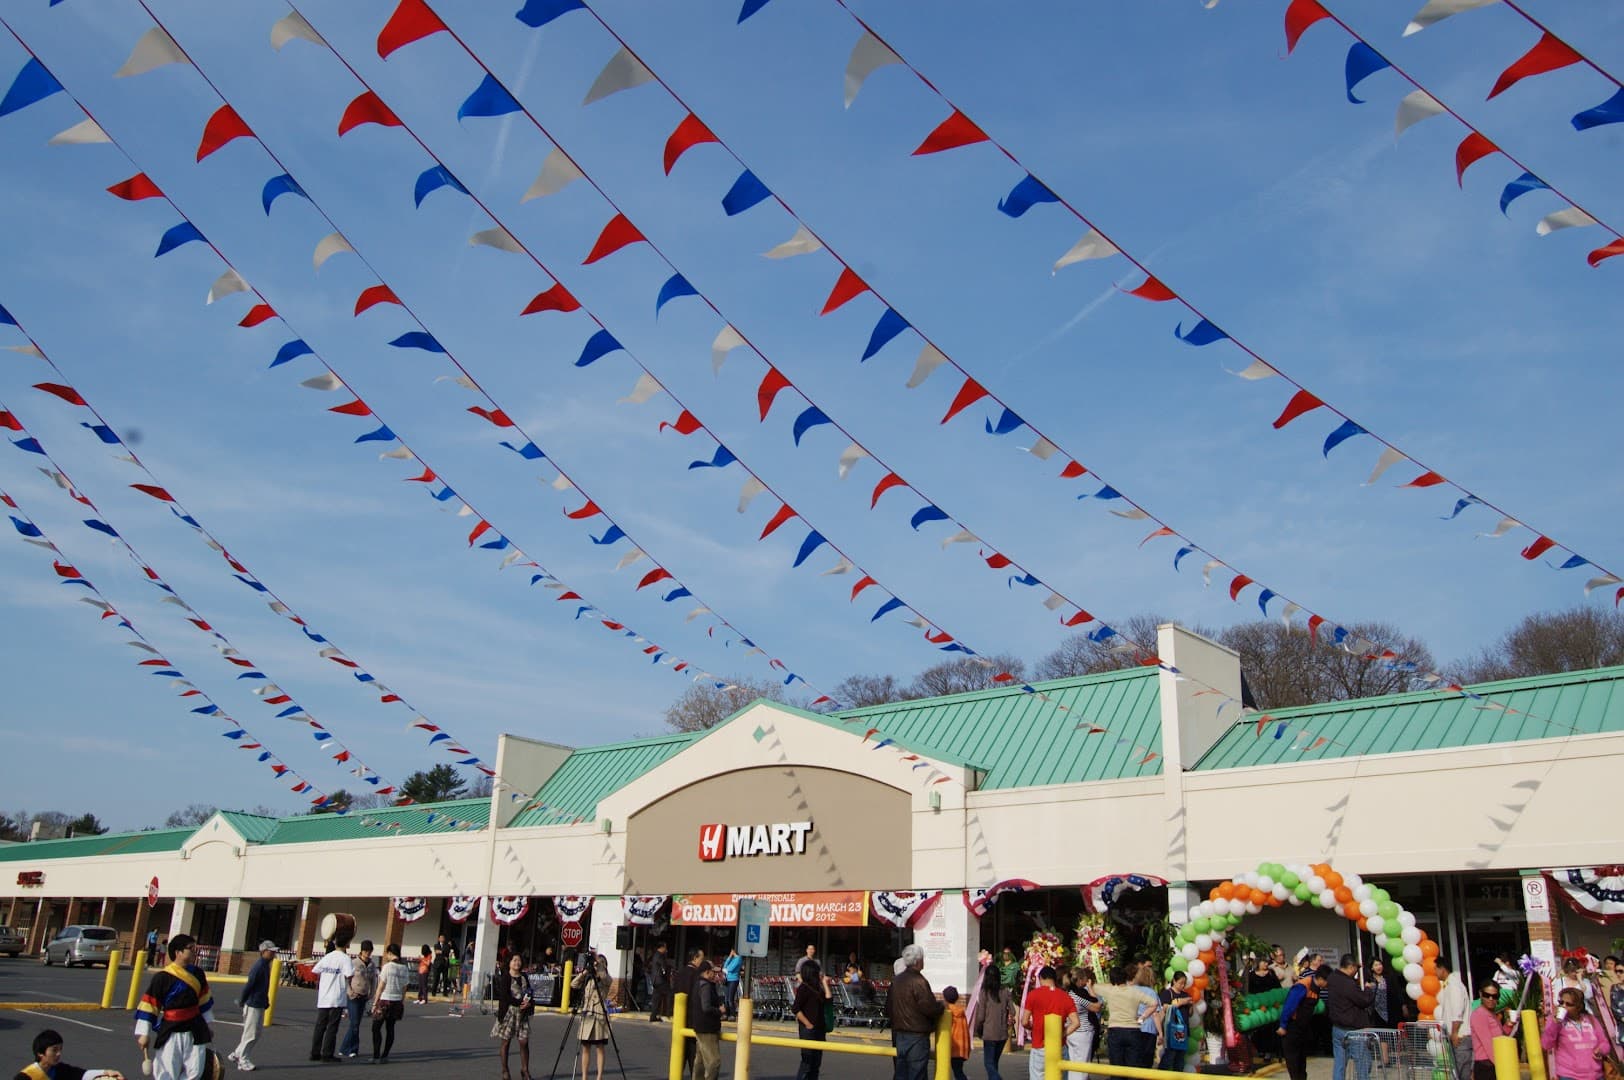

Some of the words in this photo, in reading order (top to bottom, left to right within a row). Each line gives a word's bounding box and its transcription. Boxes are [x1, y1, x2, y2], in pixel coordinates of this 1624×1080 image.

[701, 824, 722, 859] H
[726, 822, 812, 855] MART
[682, 904, 737, 922] GRAND
[769, 903, 815, 922] NING
[816, 903, 847, 913] MARCH
[848, 902, 862, 912] 23
[815, 913, 836, 921] 2012
[563, 928, 581, 939] STOP
